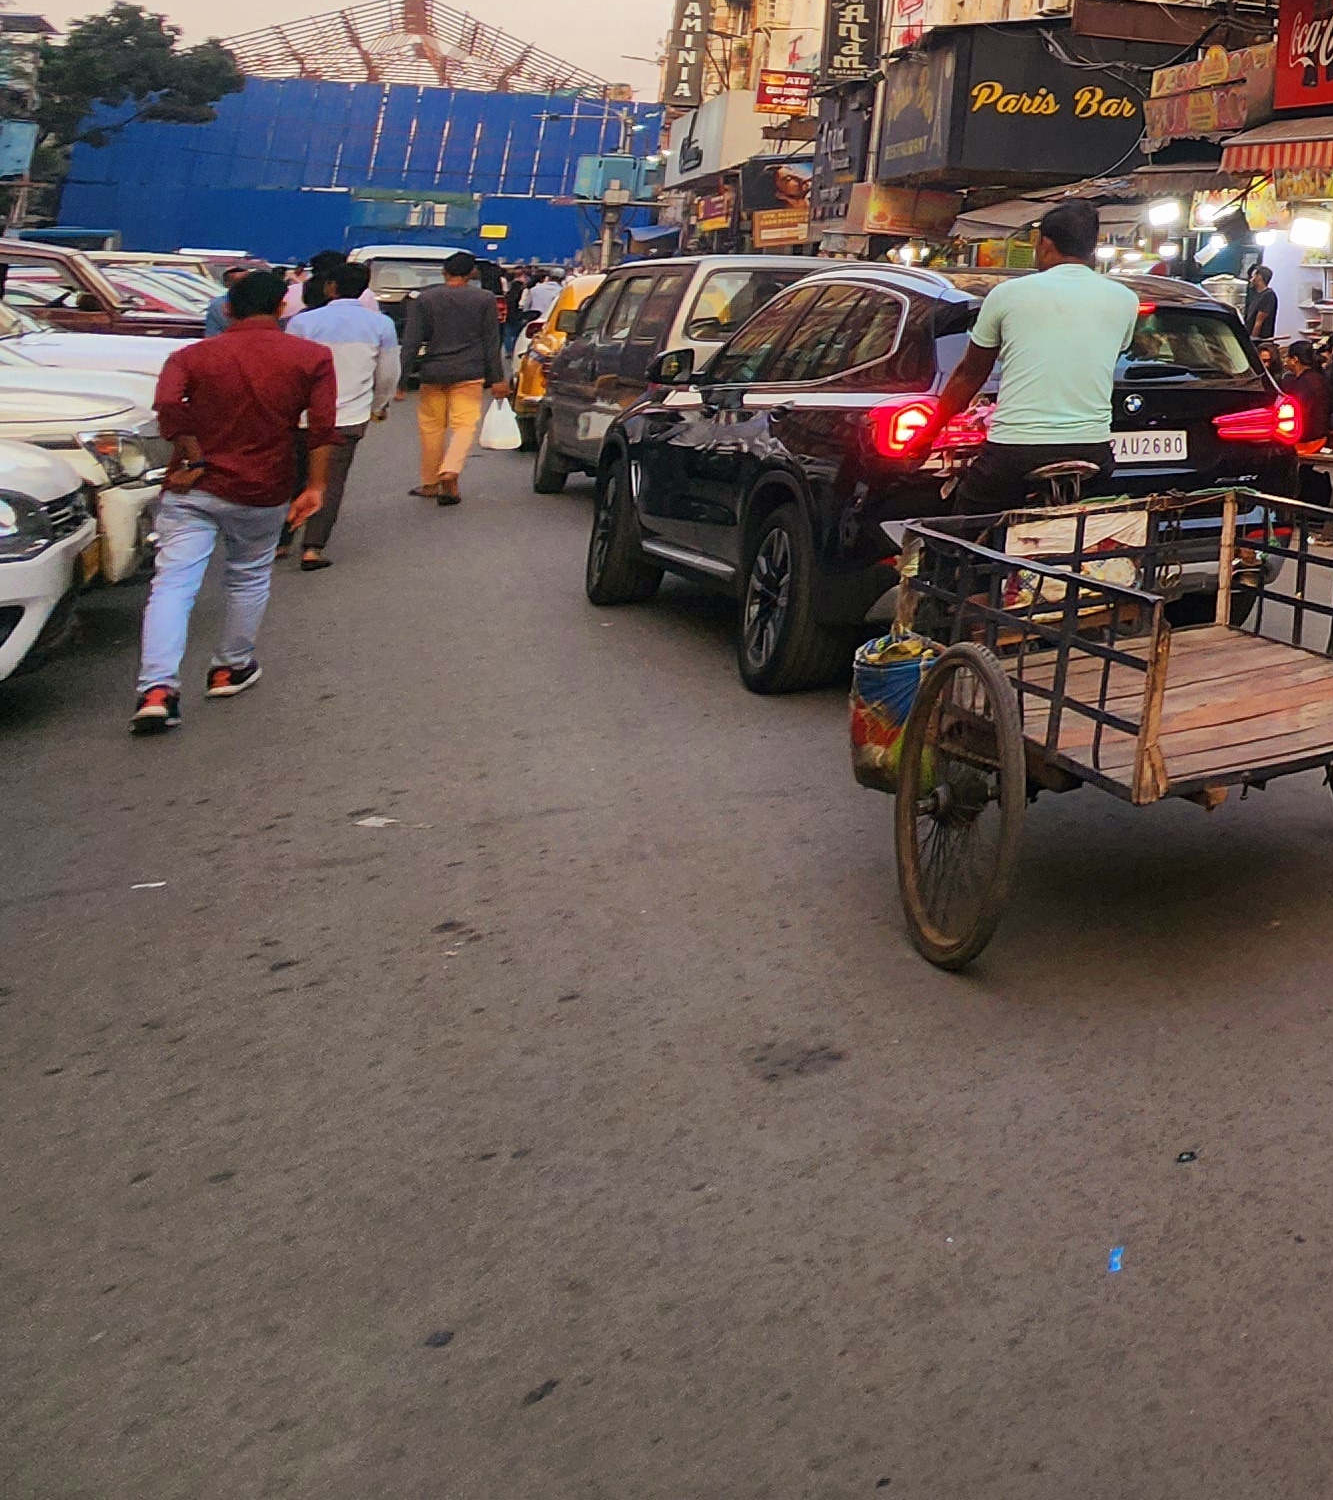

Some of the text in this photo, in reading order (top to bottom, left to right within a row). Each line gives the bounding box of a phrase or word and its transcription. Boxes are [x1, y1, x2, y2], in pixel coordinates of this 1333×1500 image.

[676, 2, 703, 97] AMINIA
[784, 76, 811, 86] ATM
[970, 81, 1137, 118] Paris Bar
